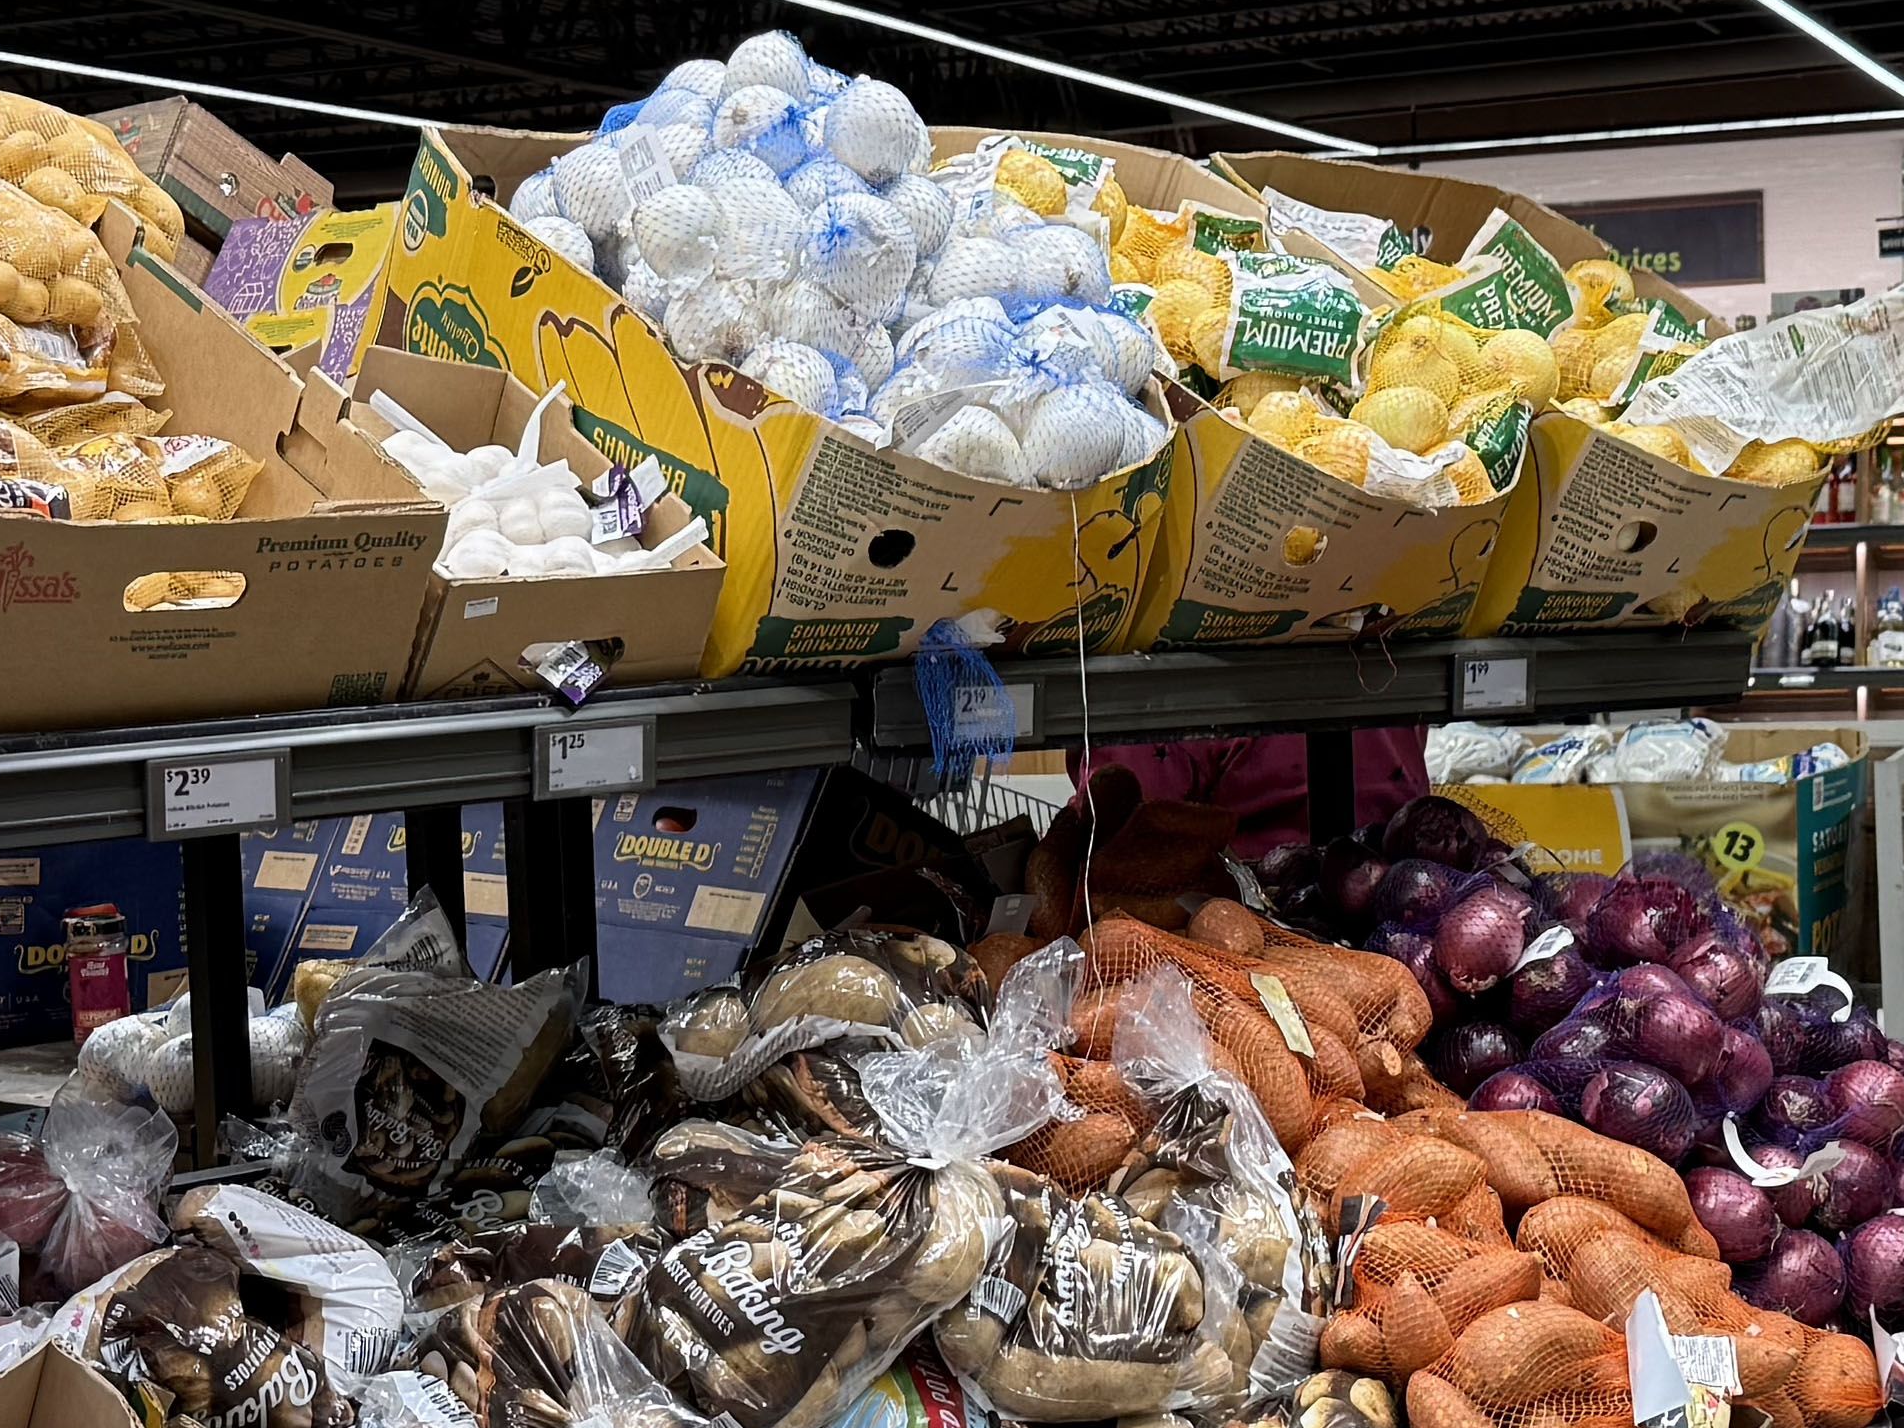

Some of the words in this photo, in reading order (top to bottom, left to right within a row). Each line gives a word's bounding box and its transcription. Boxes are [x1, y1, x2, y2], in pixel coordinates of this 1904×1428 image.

[1243, 319, 1350, 362] PREMIUM
[593, 426, 687, 499] BAANAS
[256, 534, 350, 554] Premium
[353, 532, 428, 554] Quality
[268, 554, 404, 574] POTATOES
[620, 836, 690, 863] DOUBLE
[690, 843, 712, 864] D
[1723, 830, 1756, 863] 13
[689, 1280, 736, 1339] POTATOES
[699, 1239, 806, 1356] Baking
